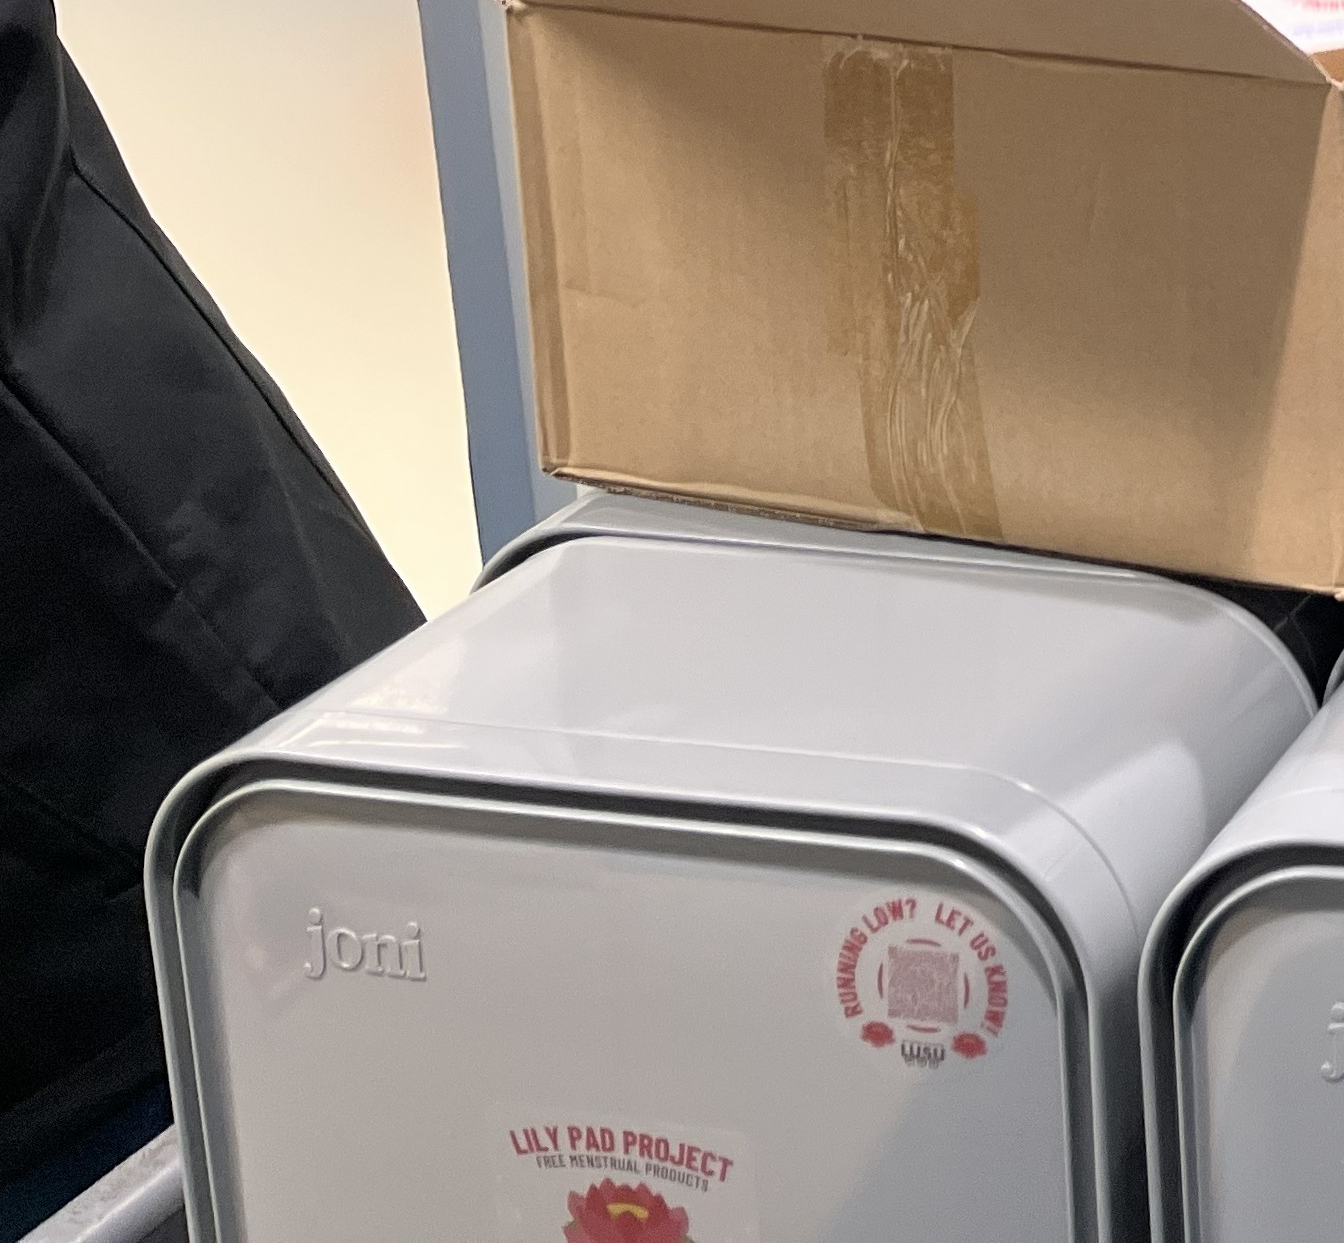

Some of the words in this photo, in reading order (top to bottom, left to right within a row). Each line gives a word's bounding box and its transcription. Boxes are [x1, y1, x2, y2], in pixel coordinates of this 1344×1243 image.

[303, 907, 427, 982] joni
[935, 903, 975, 936] LET
[970, 930, 997, 961] US
[836, 927, 868, 1018] RUNNING
[862, 898, 917, 934] LOW?
[981, 964, 1008, 1037] KNOW!
[509, 1125, 559, 1155] LILY
[567, 1124, 615, 1153] PAD
[622, 1130, 734, 1182] PROJECT
[536, 1154, 566, 1169] FREE
[569, 1154, 640, 1175] MENSTRUAL
[645, 1163, 709, 1192] PRODUCTS
